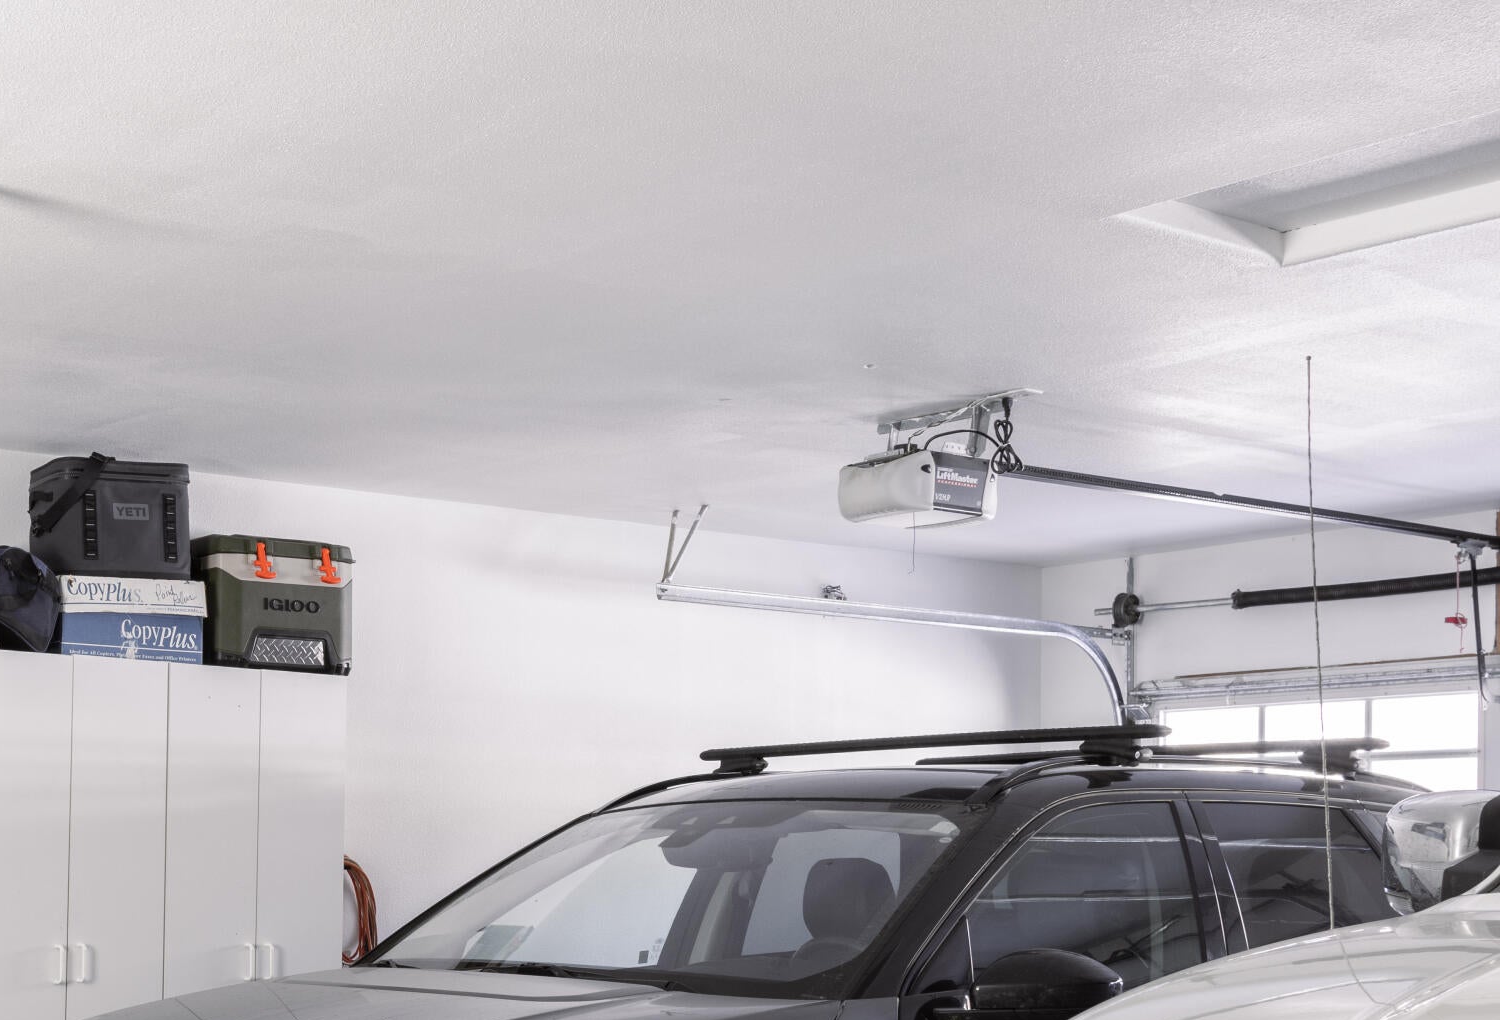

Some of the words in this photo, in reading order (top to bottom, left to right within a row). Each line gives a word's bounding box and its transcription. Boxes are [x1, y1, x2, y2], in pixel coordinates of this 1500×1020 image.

[936, 470, 979, 484] LiftMaster
[115, 506, 147, 518] YETI
[67, 577, 141, 602] CopyPlus
[263, 597, 321, 614] IGLOO
[121, 619, 197, 650] CopyPlus
